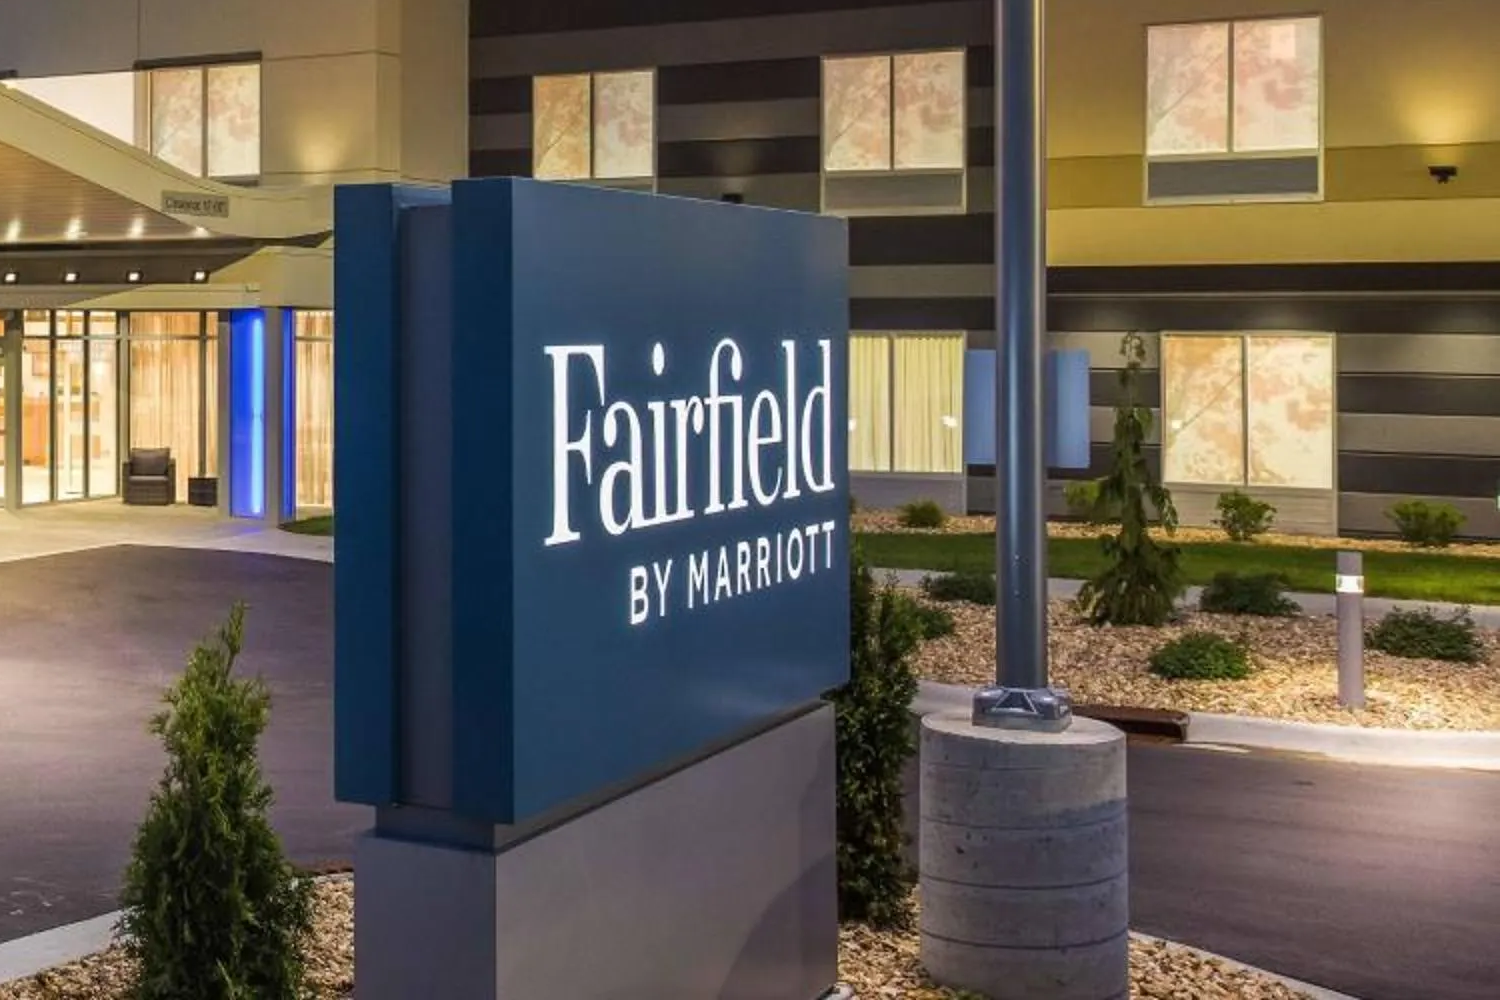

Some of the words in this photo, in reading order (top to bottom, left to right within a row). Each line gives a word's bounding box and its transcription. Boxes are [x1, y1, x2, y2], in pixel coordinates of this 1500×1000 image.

[543, 337, 836, 547] Fairfield
[629, 559, 673, 626] BY
[687, 520, 836, 610] MARRIOTT
